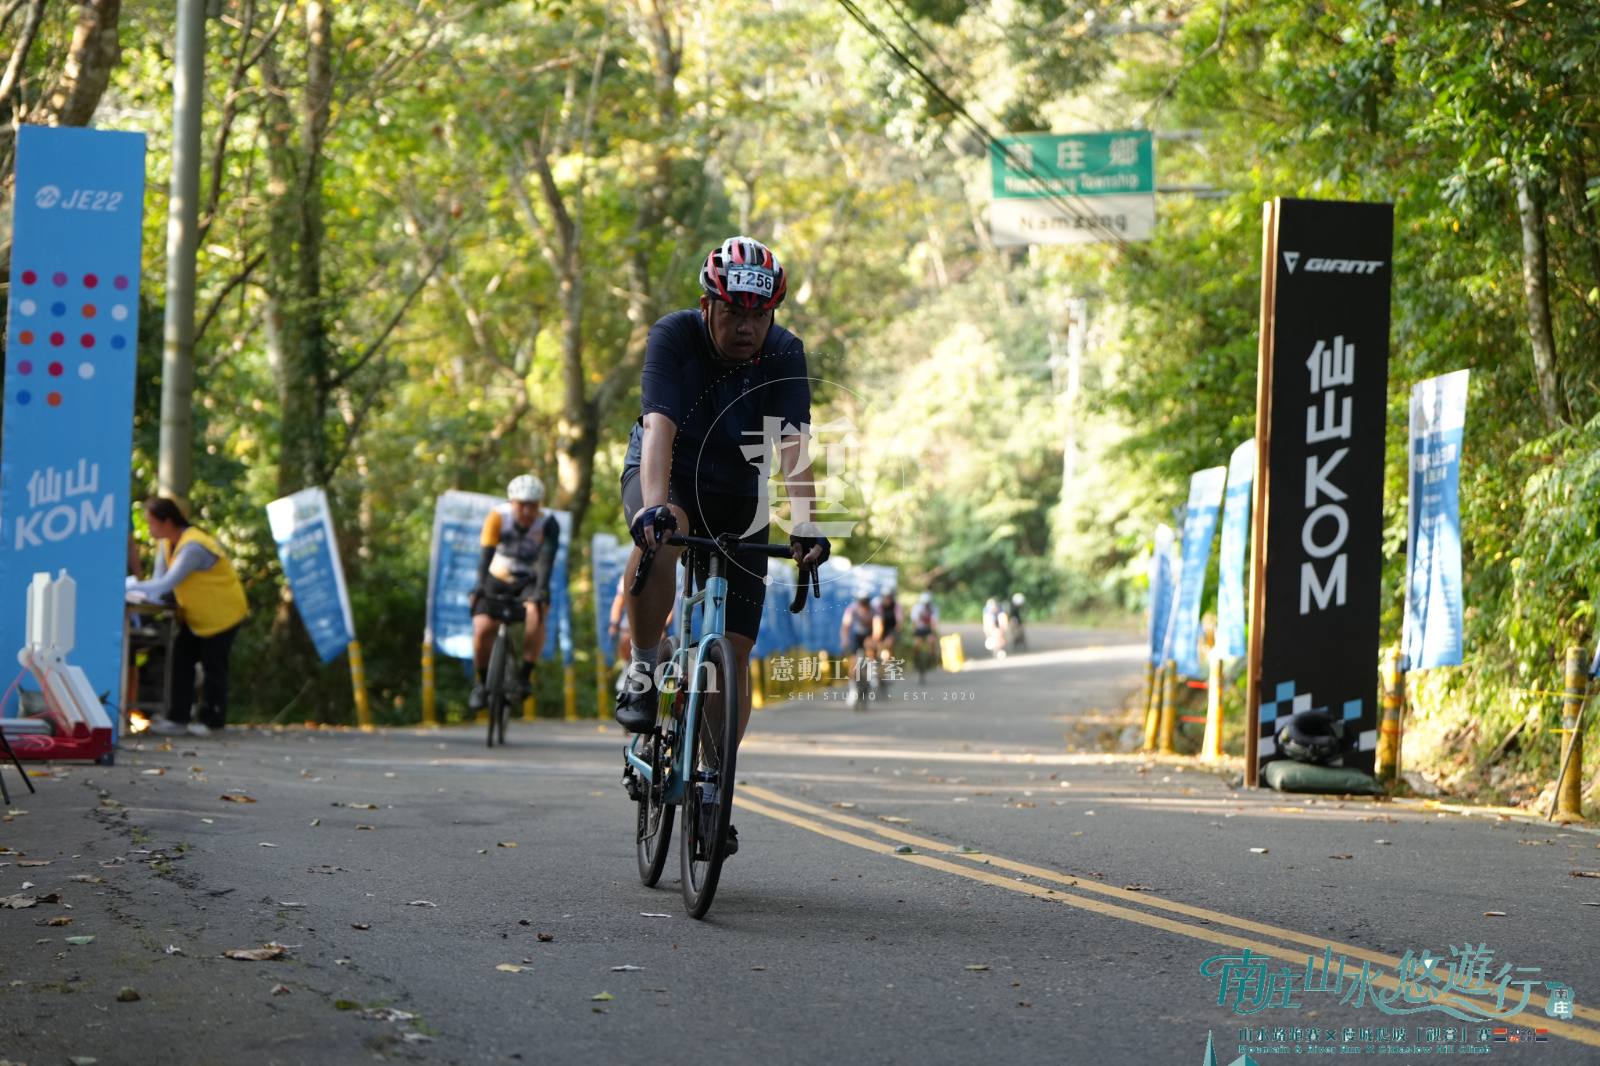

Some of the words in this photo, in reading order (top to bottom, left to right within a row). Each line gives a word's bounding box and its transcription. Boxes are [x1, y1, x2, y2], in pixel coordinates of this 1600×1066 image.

[61, 189, 123, 212] JE22
[1304, 257, 1384, 274] GIANT
[26, 458, 100, 509] 仙山
[15, 493, 115, 551] KOM
